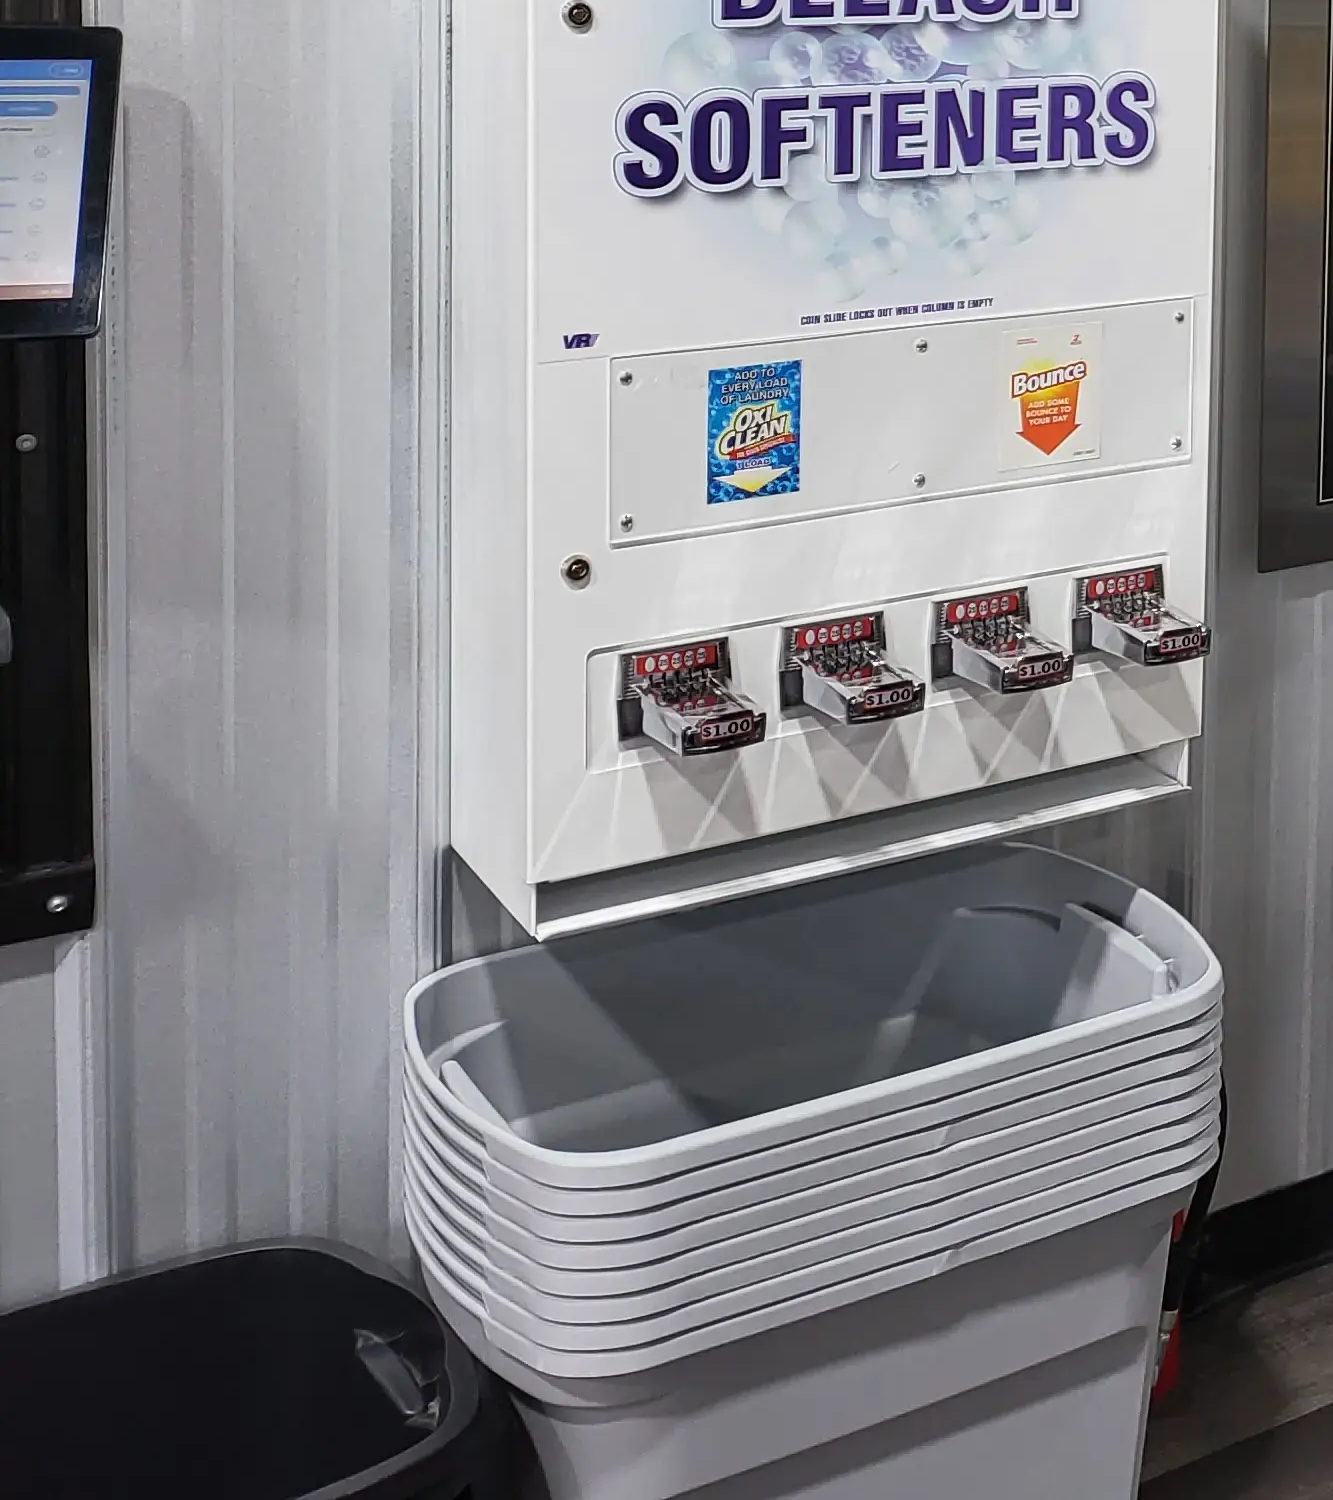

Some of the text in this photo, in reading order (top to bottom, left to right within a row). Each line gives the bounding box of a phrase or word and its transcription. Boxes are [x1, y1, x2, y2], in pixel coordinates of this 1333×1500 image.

[616, 74, 1153, 194] SOFTENERS
[800, 297, 994, 326] COIN SLIDE LOCKS OUT WHEN COLUMN IS EMPTY
[734, 367, 776, 381] ADD TO
[1011, 361, 1087, 398] Bounce
[721, 377, 788, 394] EVERY LOAD
[720, 387, 789, 406] OF LAUNDRY
[734, 403, 775, 431] OXI
[1052, 414, 1069, 423] DAY
[1060, 405, 1072, 414] TO
[718, 414, 788, 456] CLEAN
[1161, 633, 1200, 650] $1.00
[1020, 659, 1060, 677] $1.00
[866, 688, 911, 706] $1.00
[702, 719, 750, 738] $1.00
